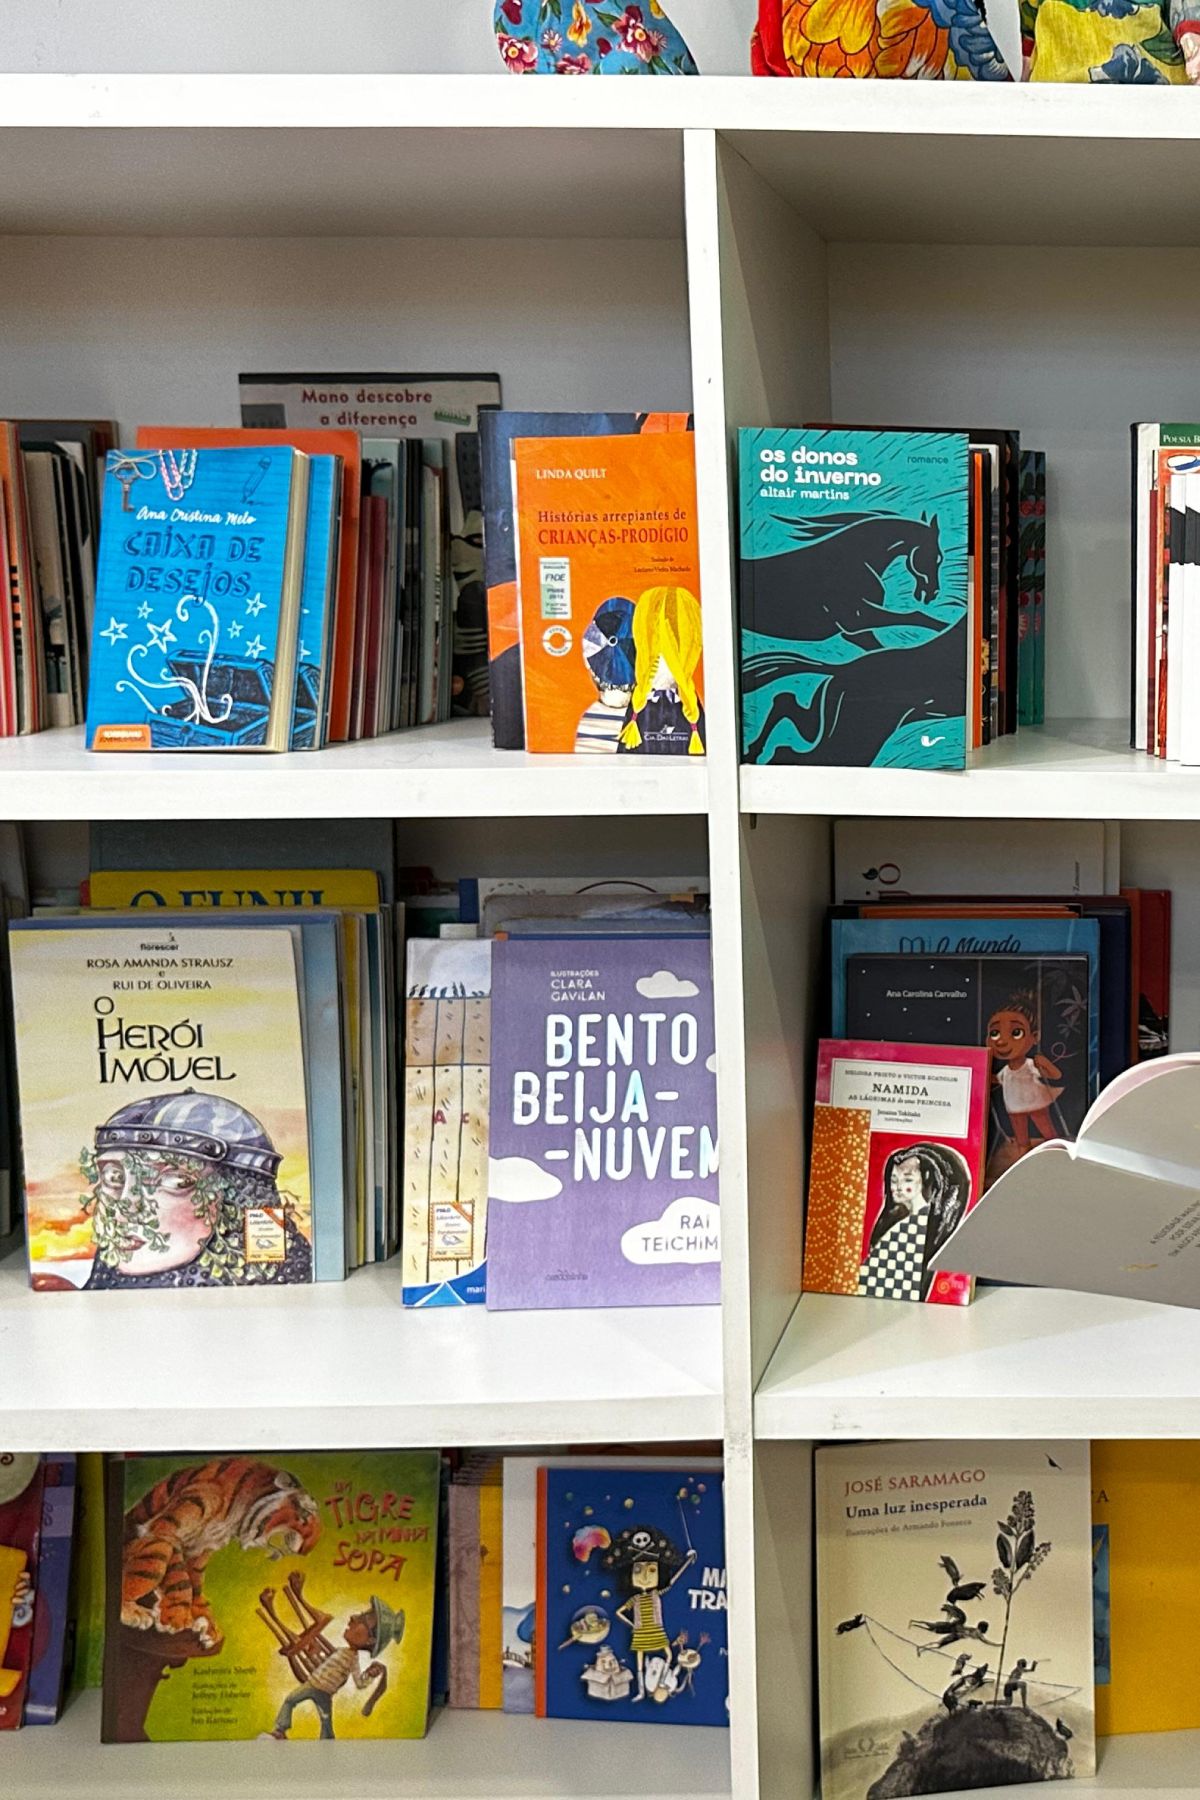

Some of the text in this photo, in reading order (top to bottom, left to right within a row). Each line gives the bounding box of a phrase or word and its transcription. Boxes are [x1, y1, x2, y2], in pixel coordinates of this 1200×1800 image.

[302, 389, 432, 404] Mano descobre
[320, 412, 418, 429] a diferença
[760, 446, 858, 466] os donos
[907, 455, 949, 464] romance
[536, 468, 607, 481] LINDA QUILT
[760, 464, 882, 486] do inverno
[760, 486, 850, 500] altair martins
[136, 505, 257, 526] Ana Cristina Melo
[538, 508, 687, 525] Histórias arrepiantes de
[538, 524, 689, 548] CRIANÇAS-PRODÍGIO
[227, 536, 265, 562] DE
[140, 943, 179, 951] florescer
[87, 958, 234, 968] ROSA AMANDA STRAUSZ
[159, 970, 165, 978] e
[113, 981, 211, 990] RUI DE OLIVEIRA
[551, 979, 593, 989] CLARA
[886, 990, 967, 998] Ana Carolina Carvalho
[94, 996, 115, 1016] O
[546, 1012, 698, 1067] BENTO
[513, 1070, 679, 1125] BEIJA-
[872, 1083, 929, 1097] NAMIDA
[844, 1469, 986, 1497] JOSÉ SARAMAGO
[325, 1491, 416, 1528] TIGRE
[846, 1494, 988, 1519] Uma luz inesperada
[333, 1541, 408, 1582] SOPA
